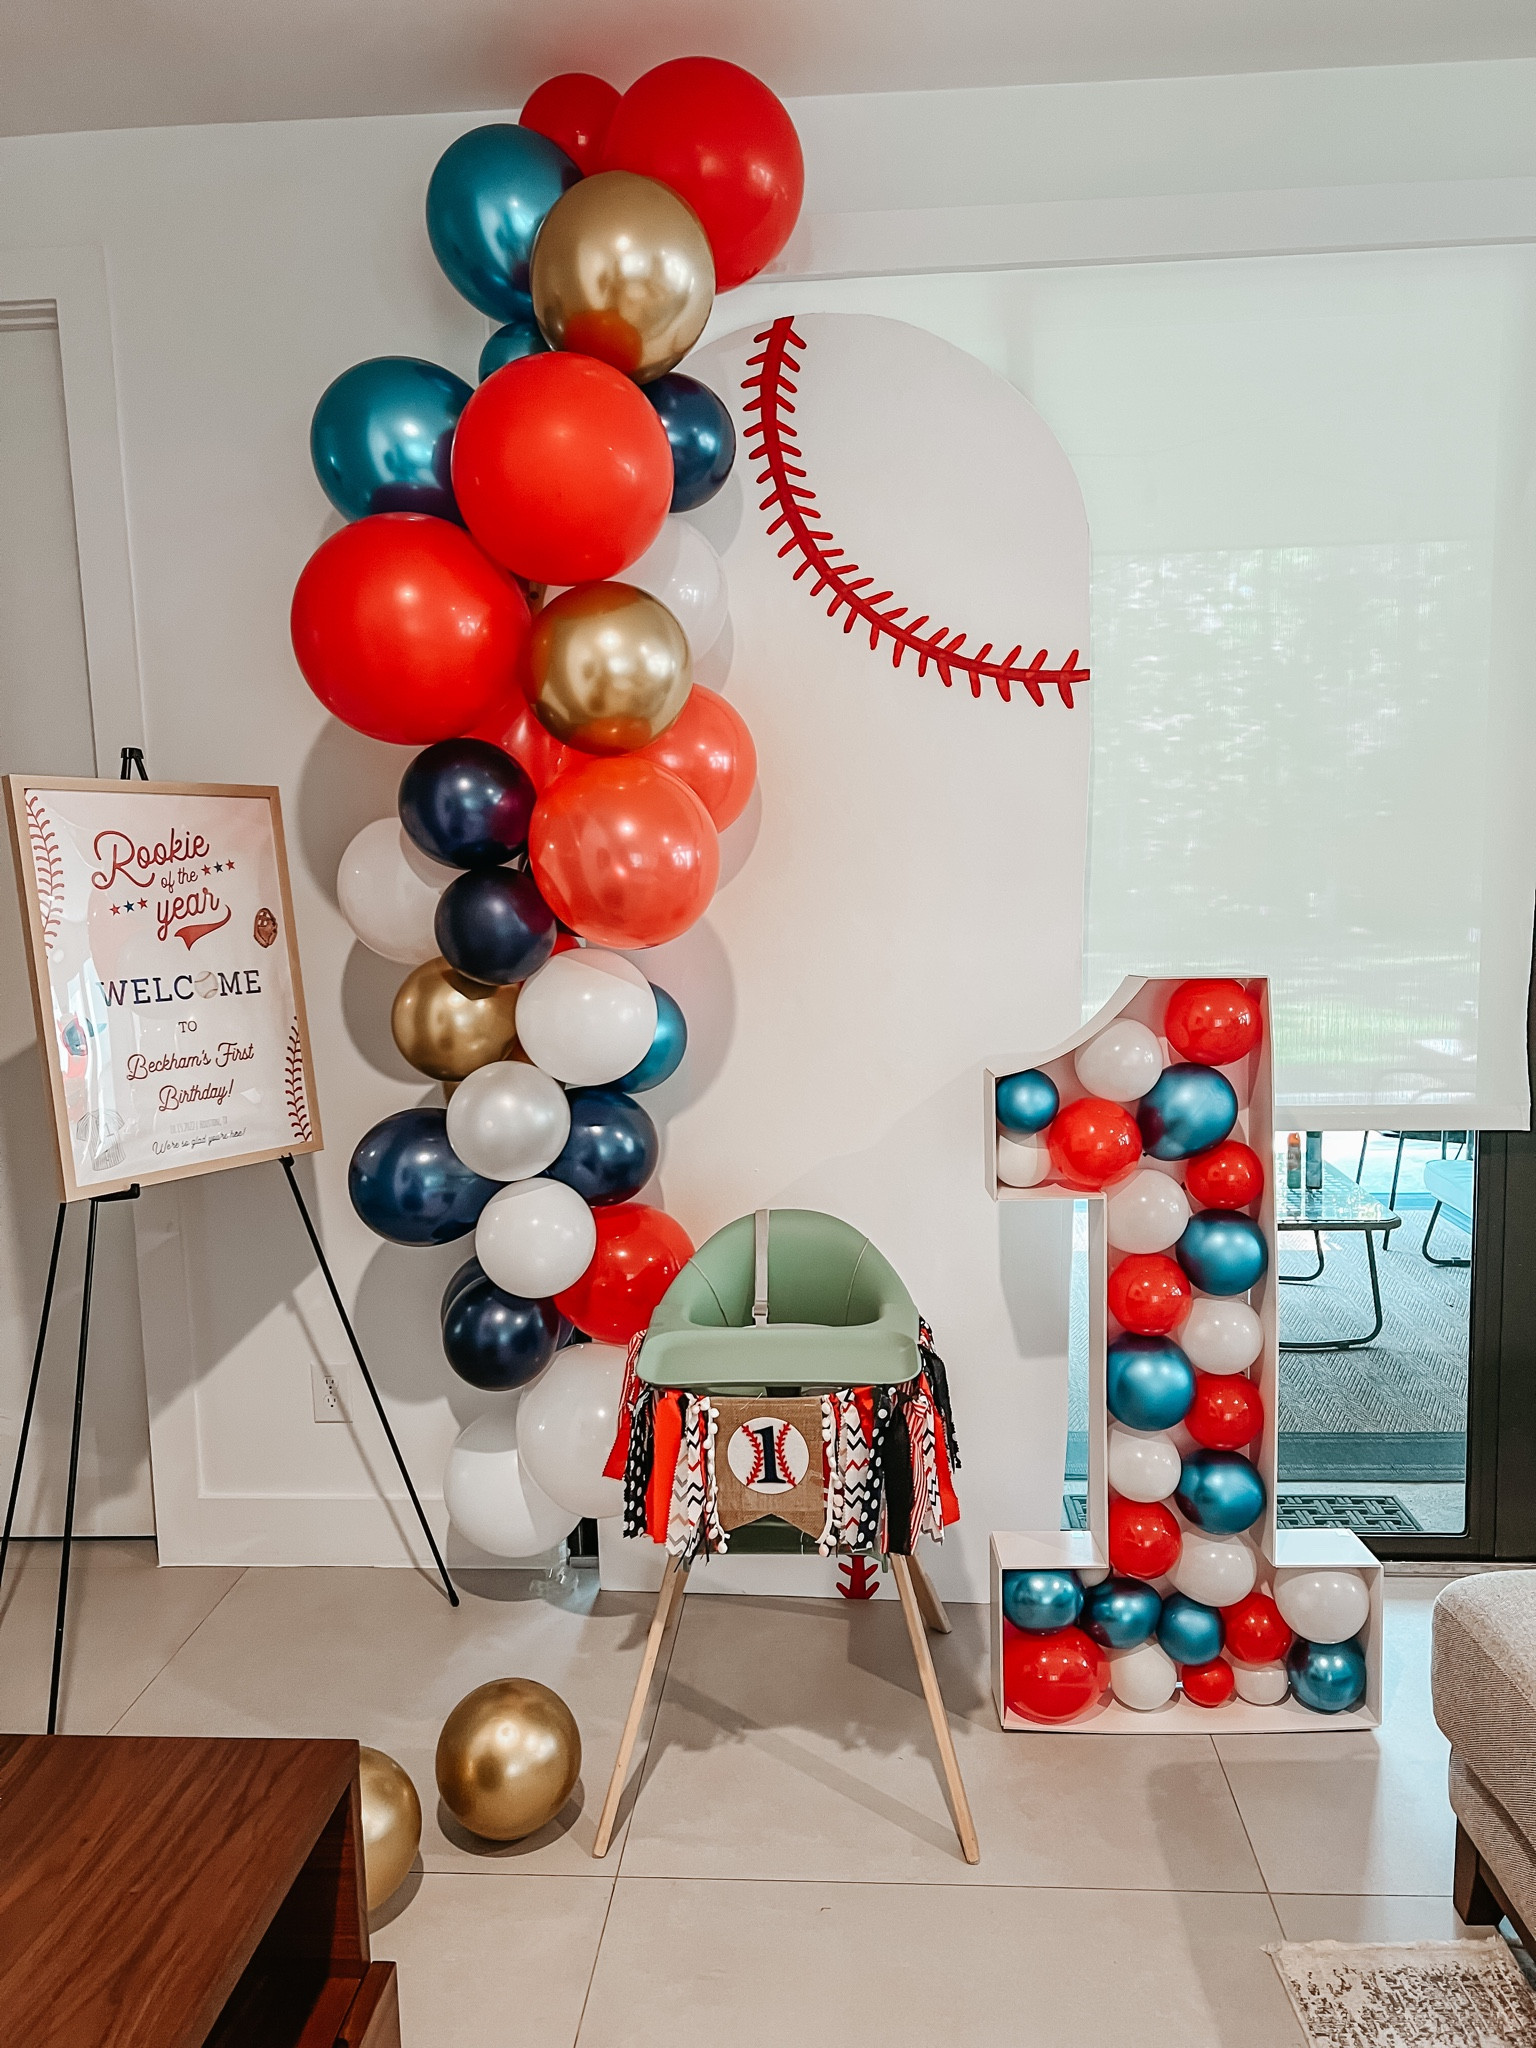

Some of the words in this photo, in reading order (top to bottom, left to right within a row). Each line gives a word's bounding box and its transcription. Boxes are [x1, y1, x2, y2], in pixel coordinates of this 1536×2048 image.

[91, 828, 210, 890] Rookie
[161, 871, 175, 893] of
[178, 867, 199, 884] the
[157, 887, 220, 941] year
[178, 1020, 198, 1033] TO
[126, 1049, 212, 1081] Beckham's
[215, 1042, 255, 1068] First
[158, 1078, 234, 1112] Birthday!
[753, 1425, 787, 1484] 1
